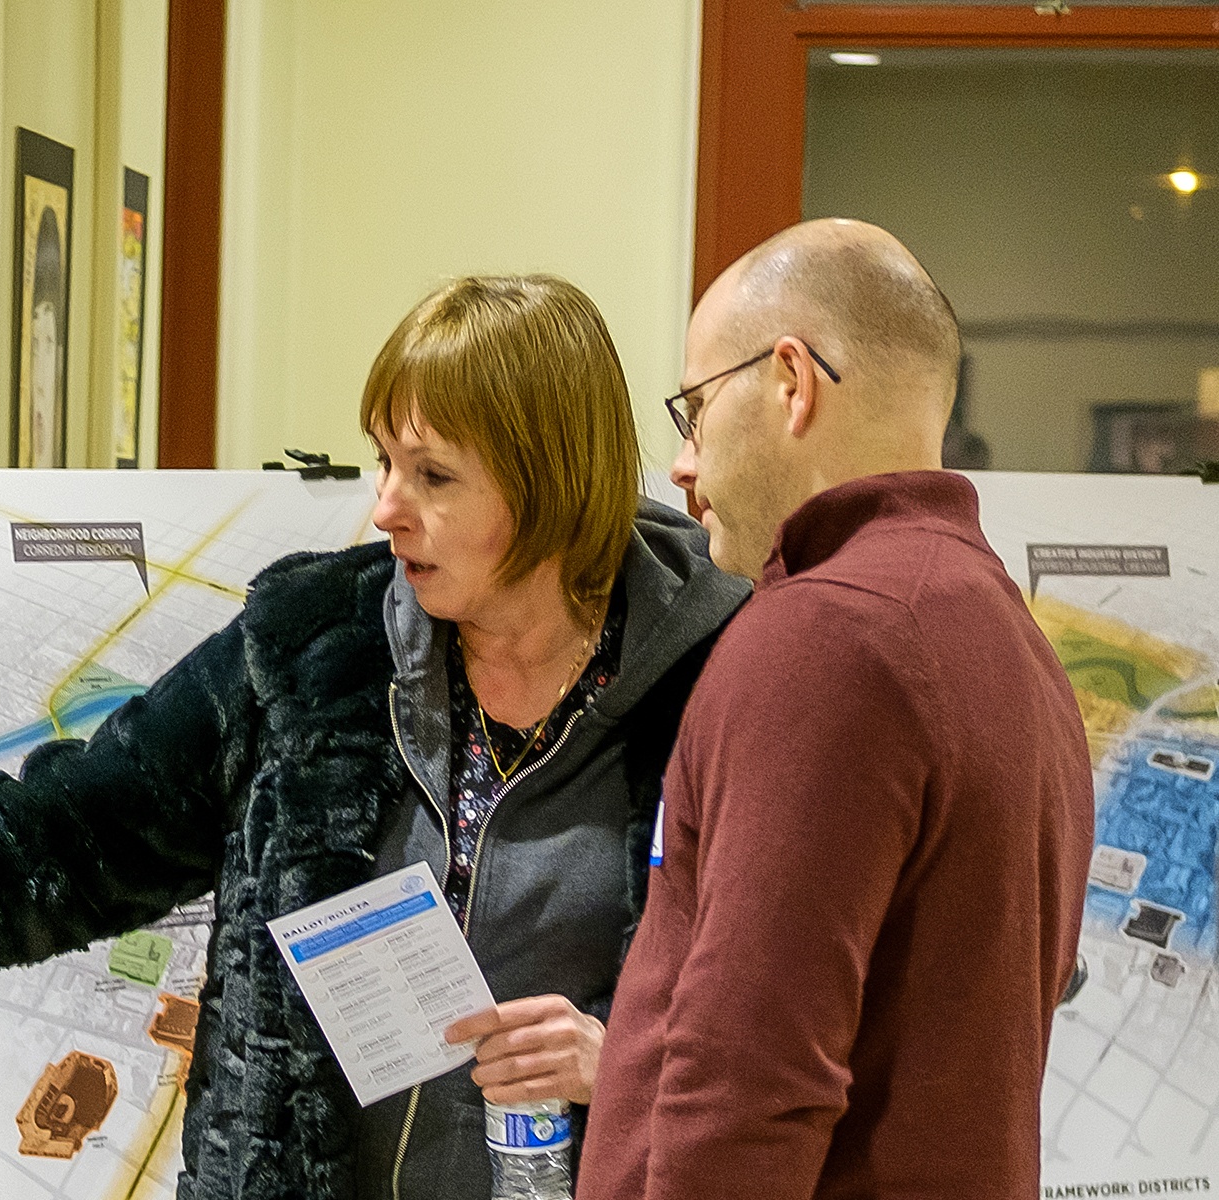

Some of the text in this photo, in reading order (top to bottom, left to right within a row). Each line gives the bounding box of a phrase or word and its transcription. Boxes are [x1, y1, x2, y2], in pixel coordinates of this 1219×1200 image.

[14, 527, 141, 541] NEIGHBORHOOD CORRIDOR
[23, 543, 136, 557] CORREDOR RESIDENCIAL
[282, 899, 371, 940] BALLOT/BOLETA
[1044, 1177, 1210, 1199] RAMEWORK: DISTRICTS
